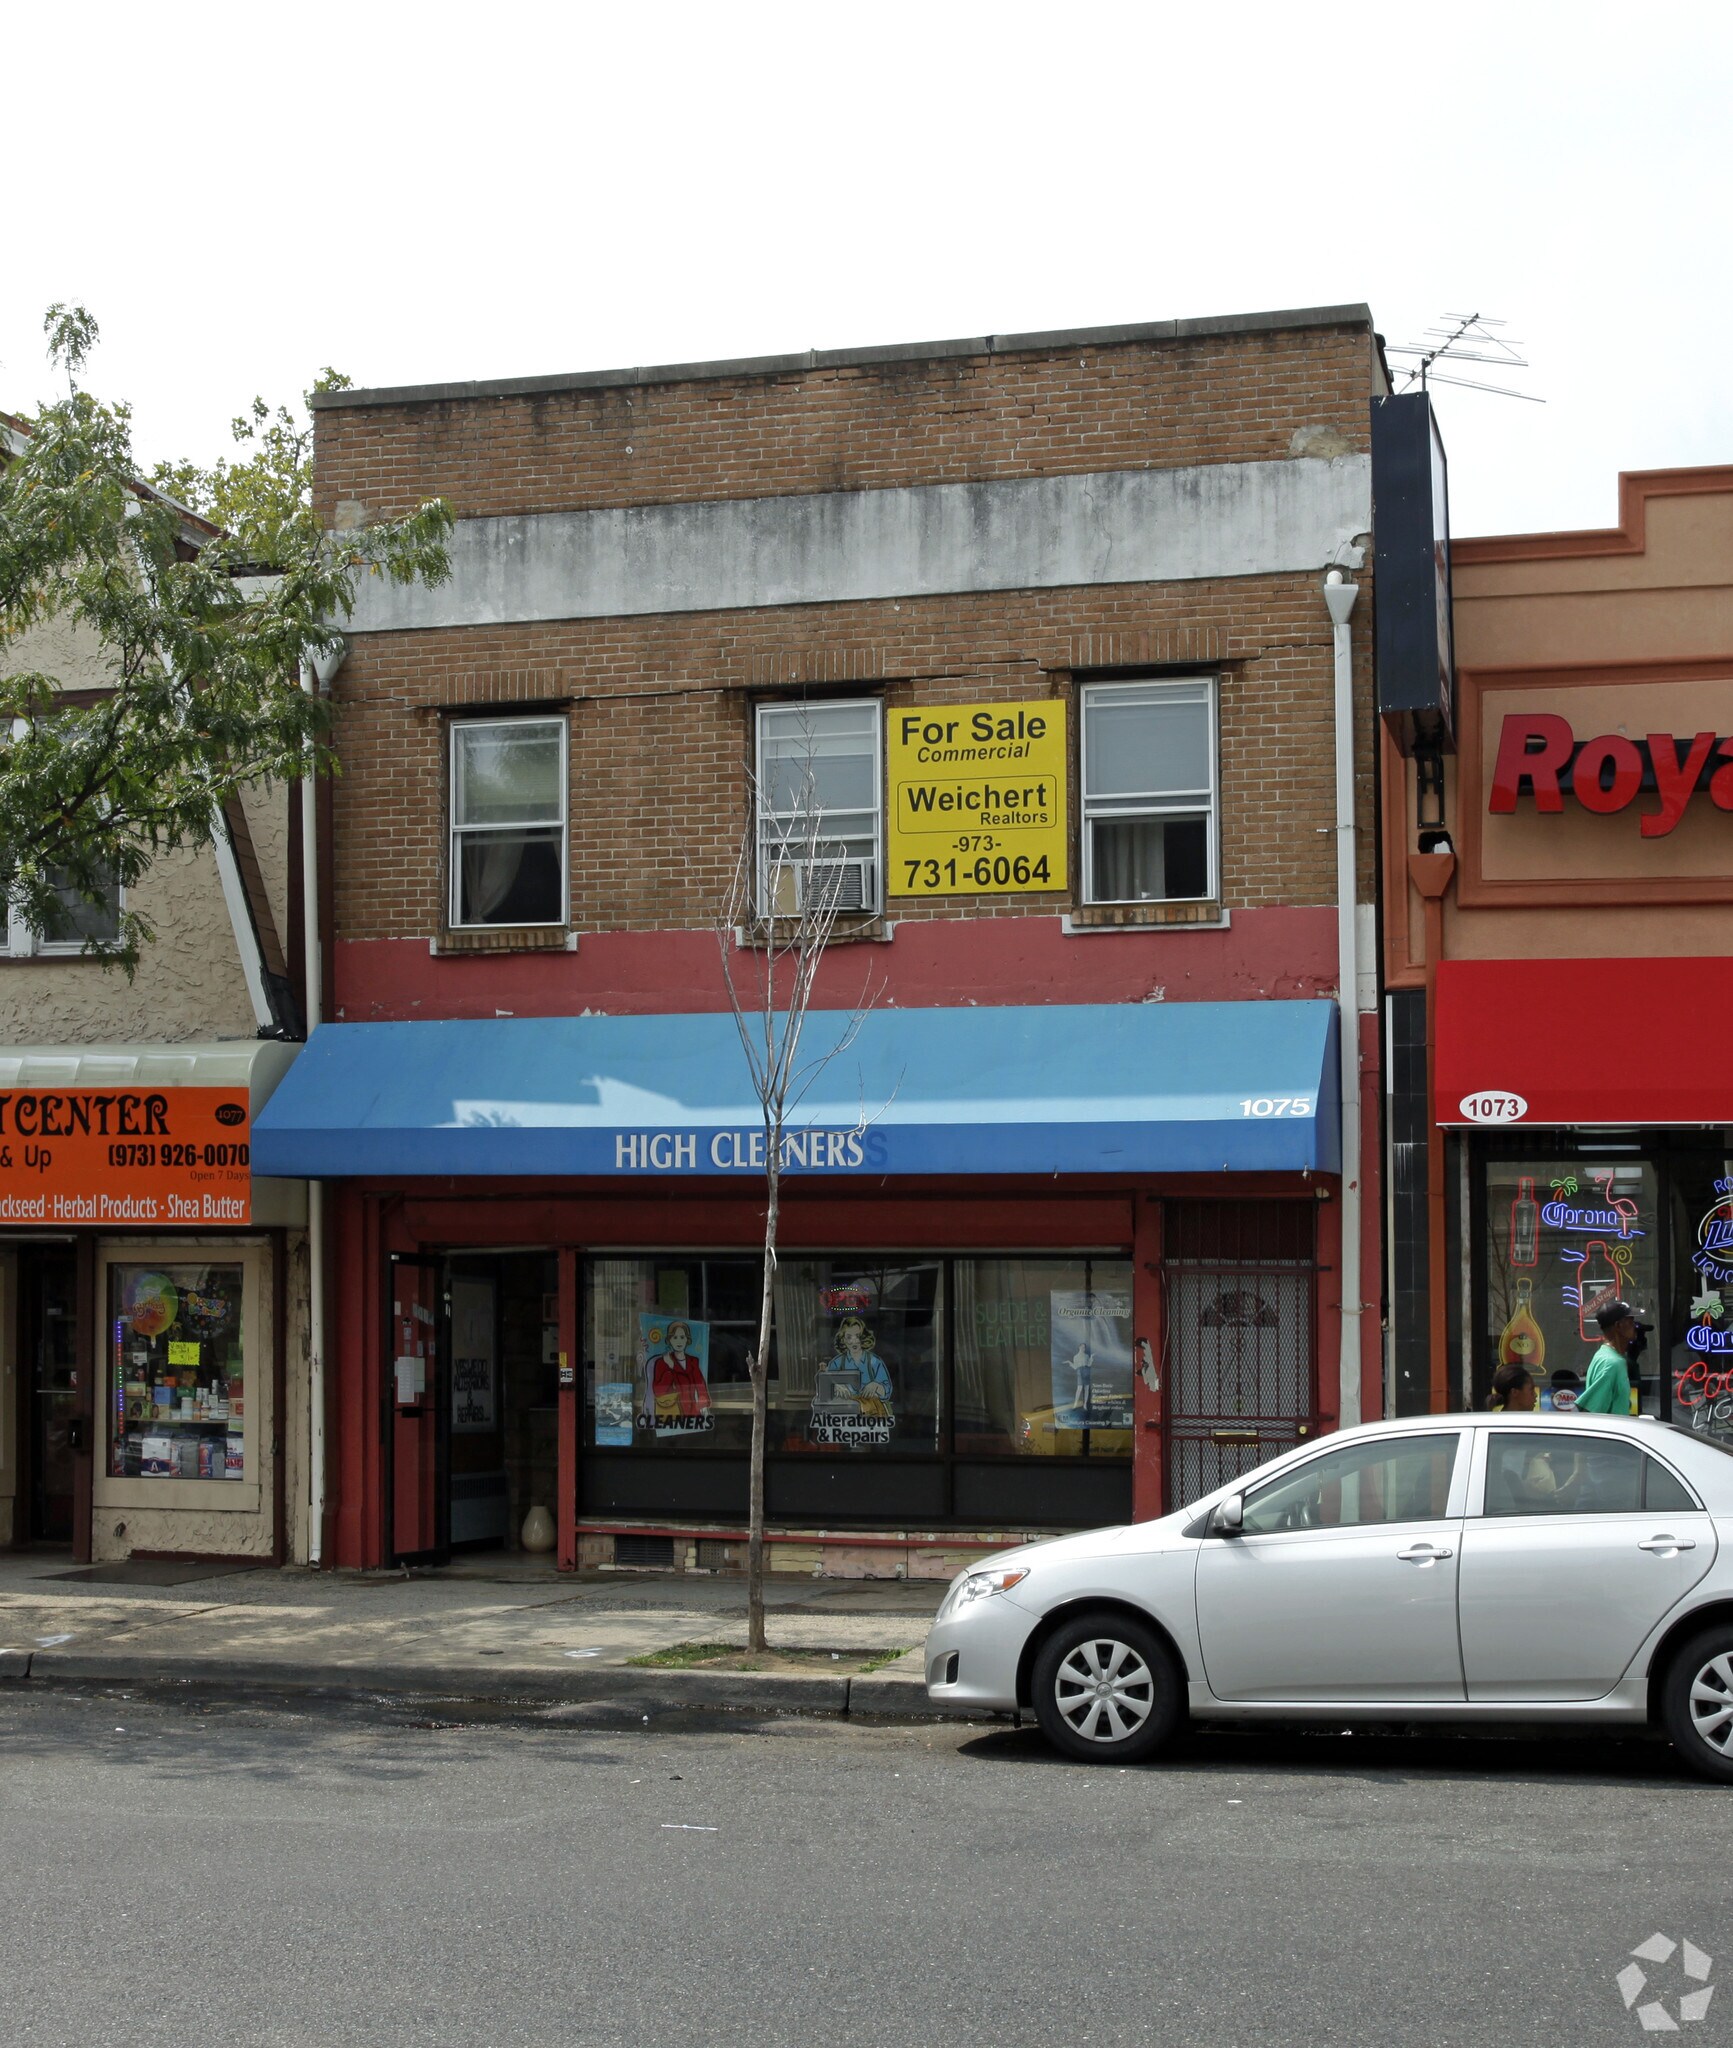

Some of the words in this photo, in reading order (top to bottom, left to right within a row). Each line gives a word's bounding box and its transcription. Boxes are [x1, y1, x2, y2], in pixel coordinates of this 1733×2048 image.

[901, 716, 959, 745] For
[971, 711, 1046, 742] Sale
[917, 742, 1030, 763] Commercial
[907, 783, 1047, 812] Weichert
[980, 811, 1048, 825] Realtors
[952, 835, 1002, 852] -973-
[904, 854, 1050, 888] 731-6064
[15, 1094, 171, 1136] CENTER
[217, 1109, 243, 1122] 1077
[1240, 1098, 1310, 1116] 1075
[1468, 1098, 1519, 1117] 1073
[25, 1145, 51, 1173] Up
[108, 1144, 155, 1166] (973)
[161, 1143, 249, 1166] 926-0070
[615, 1133, 697, 1168] HIGH
[190, 1170, 215, 1182] Open
[218, 1170, 223, 1180] 7
[226, 1170, 249, 1182] Days
[0, 1194, 44, 1217] ckseed
[53, 1195, 96, 1217] Herbal
[100, 1194, 157, 1218] Products
[167, 1194, 199, 1218] Shea
[203, 1194, 245, 1218] Butter
[1541, 1201, 1618, 1229] Corona
[976, 1301, 1028, 1324] SUEDE
[1034, 1301, 1047, 1323] &
[1057, 1306, 1092, 1319] Organic
[1093, 1306, 1131, 1319] Cleaning
[979, 1326, 1048, 1348] LEATHER
[1687, 1326, 1733, 1352] Cor
[637, 1413, 714, 1431] CLEANERS
[811, 1412, 895, 1427] Alterations
[818, 1428, 830, 1442] &
[832, 1427, 889, 1446] Repairs
